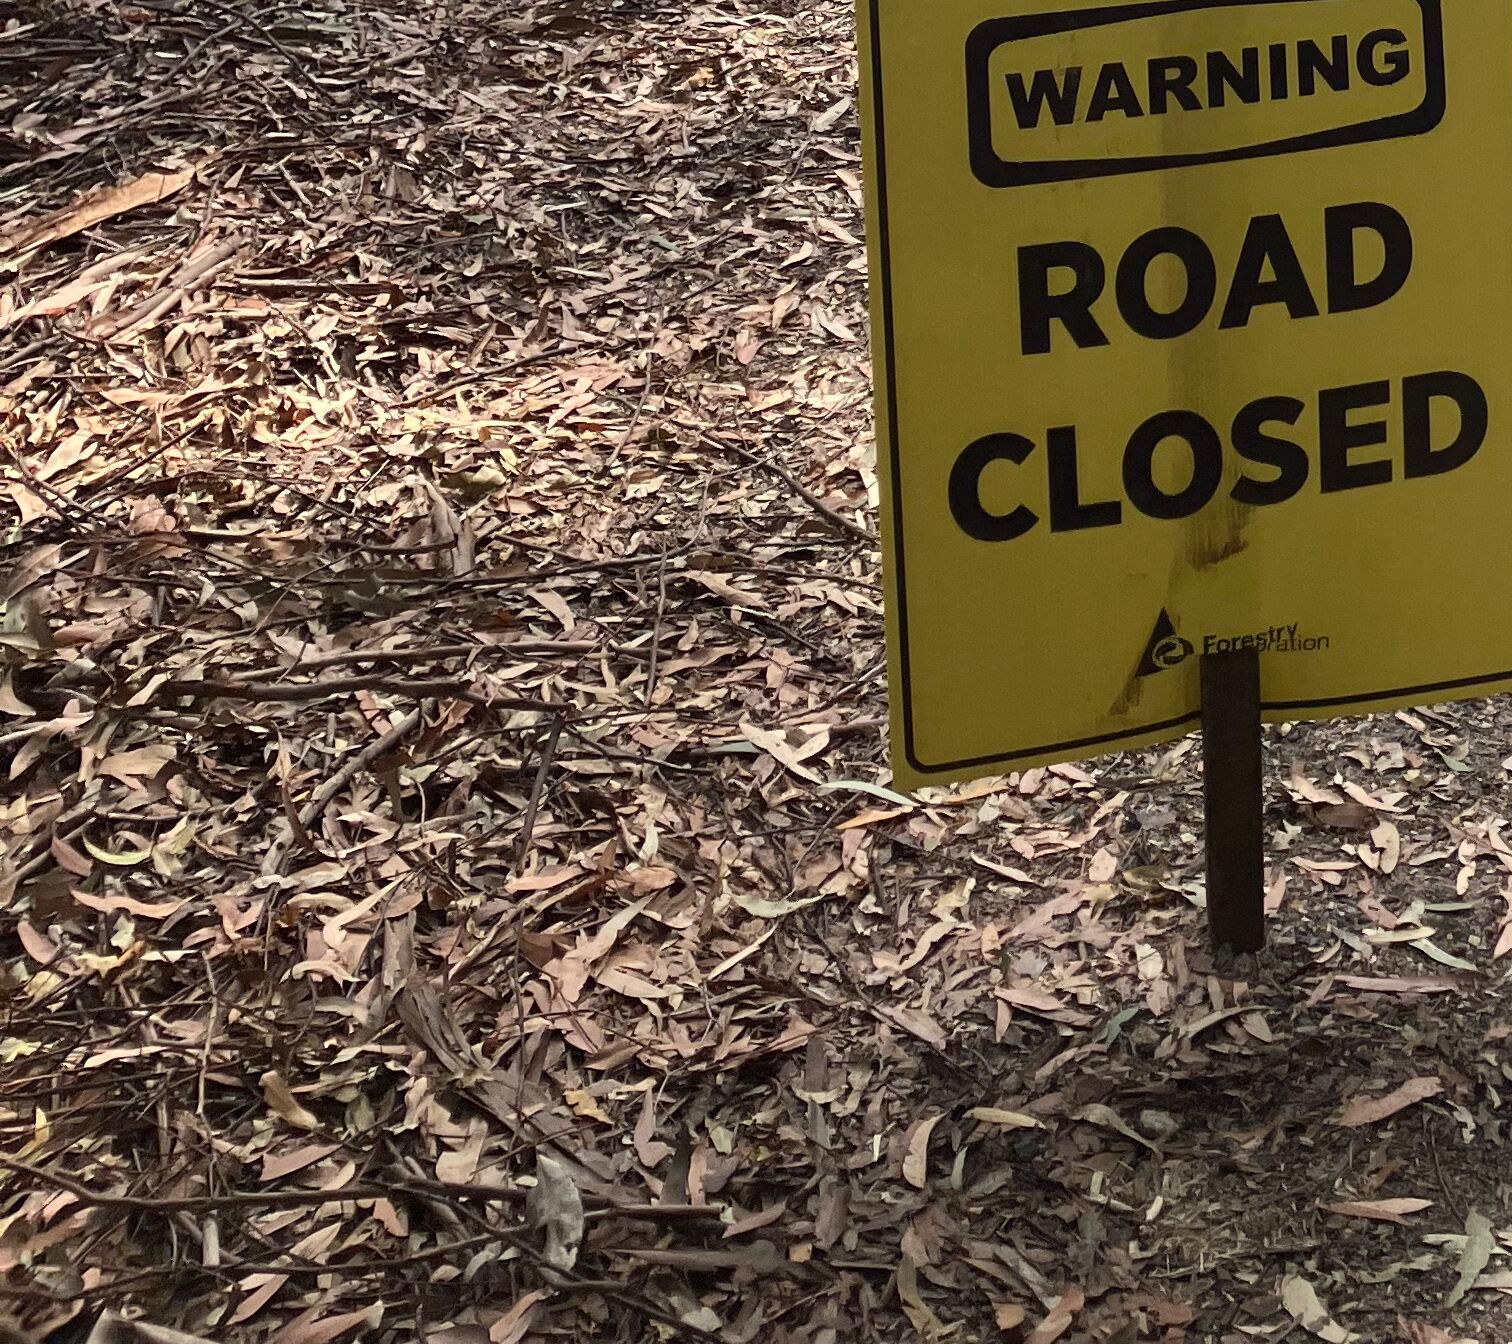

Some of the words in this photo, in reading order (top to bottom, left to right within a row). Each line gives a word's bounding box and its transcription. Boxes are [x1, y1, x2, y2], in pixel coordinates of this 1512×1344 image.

[1005, 28, 1410, 130] WARNING
[1016, 201, 1414, 356] ROAD
[947, 370, 1489, 543] CLOSED
[1202, 622, 1299, 656] Forestry
